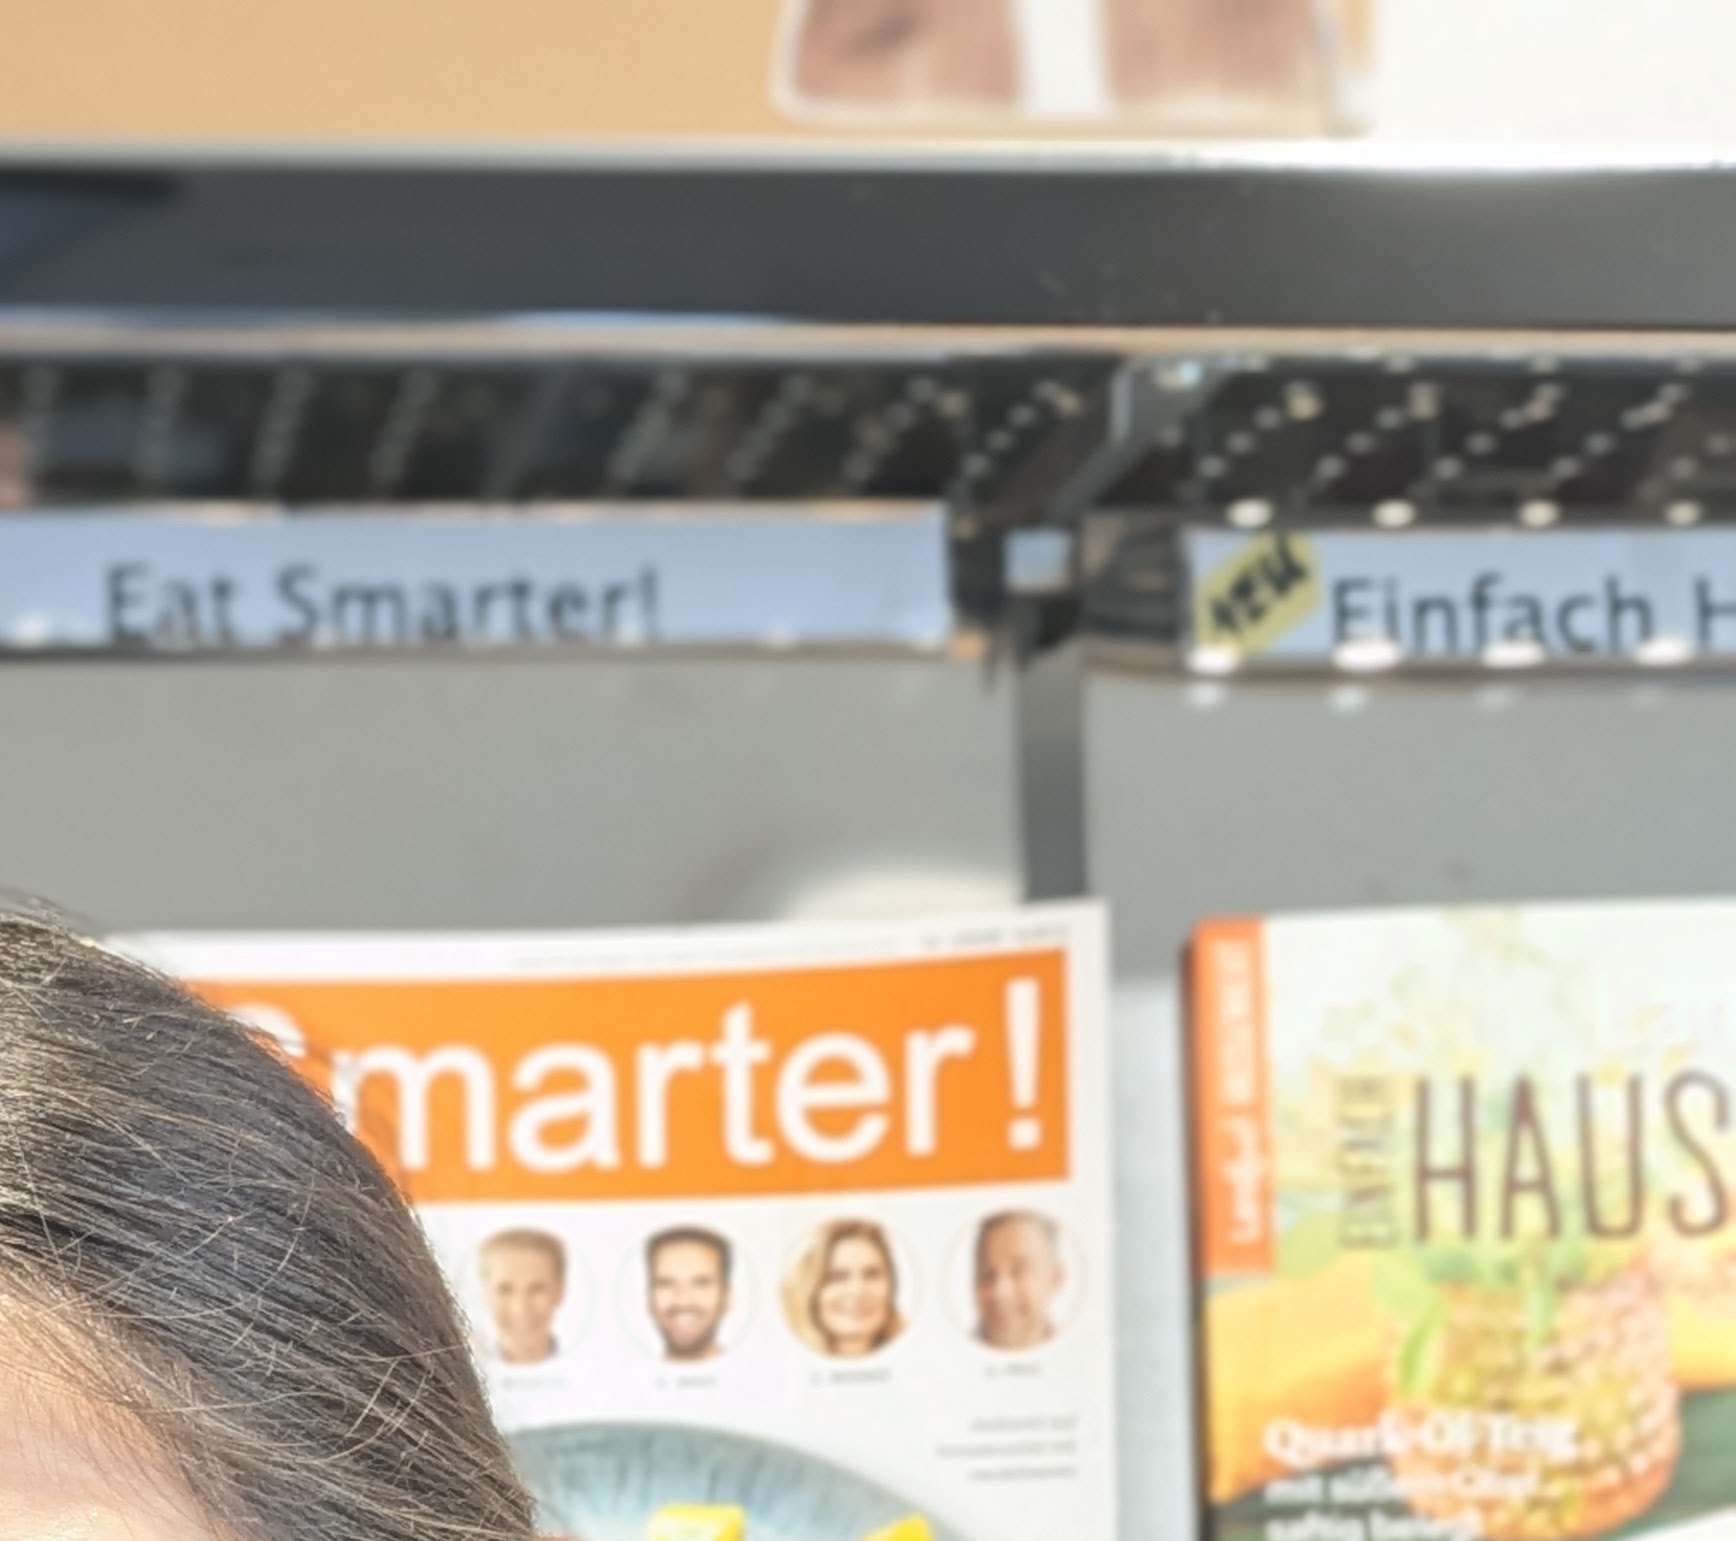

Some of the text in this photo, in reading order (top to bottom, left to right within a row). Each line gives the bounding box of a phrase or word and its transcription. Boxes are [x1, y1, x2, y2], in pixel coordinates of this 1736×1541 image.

[106, 556, 658, 648] Eat Smarter!
[1332, 570, 1656, 655] Einfach
[1414, 1068, 1731, 1244] HAUS
